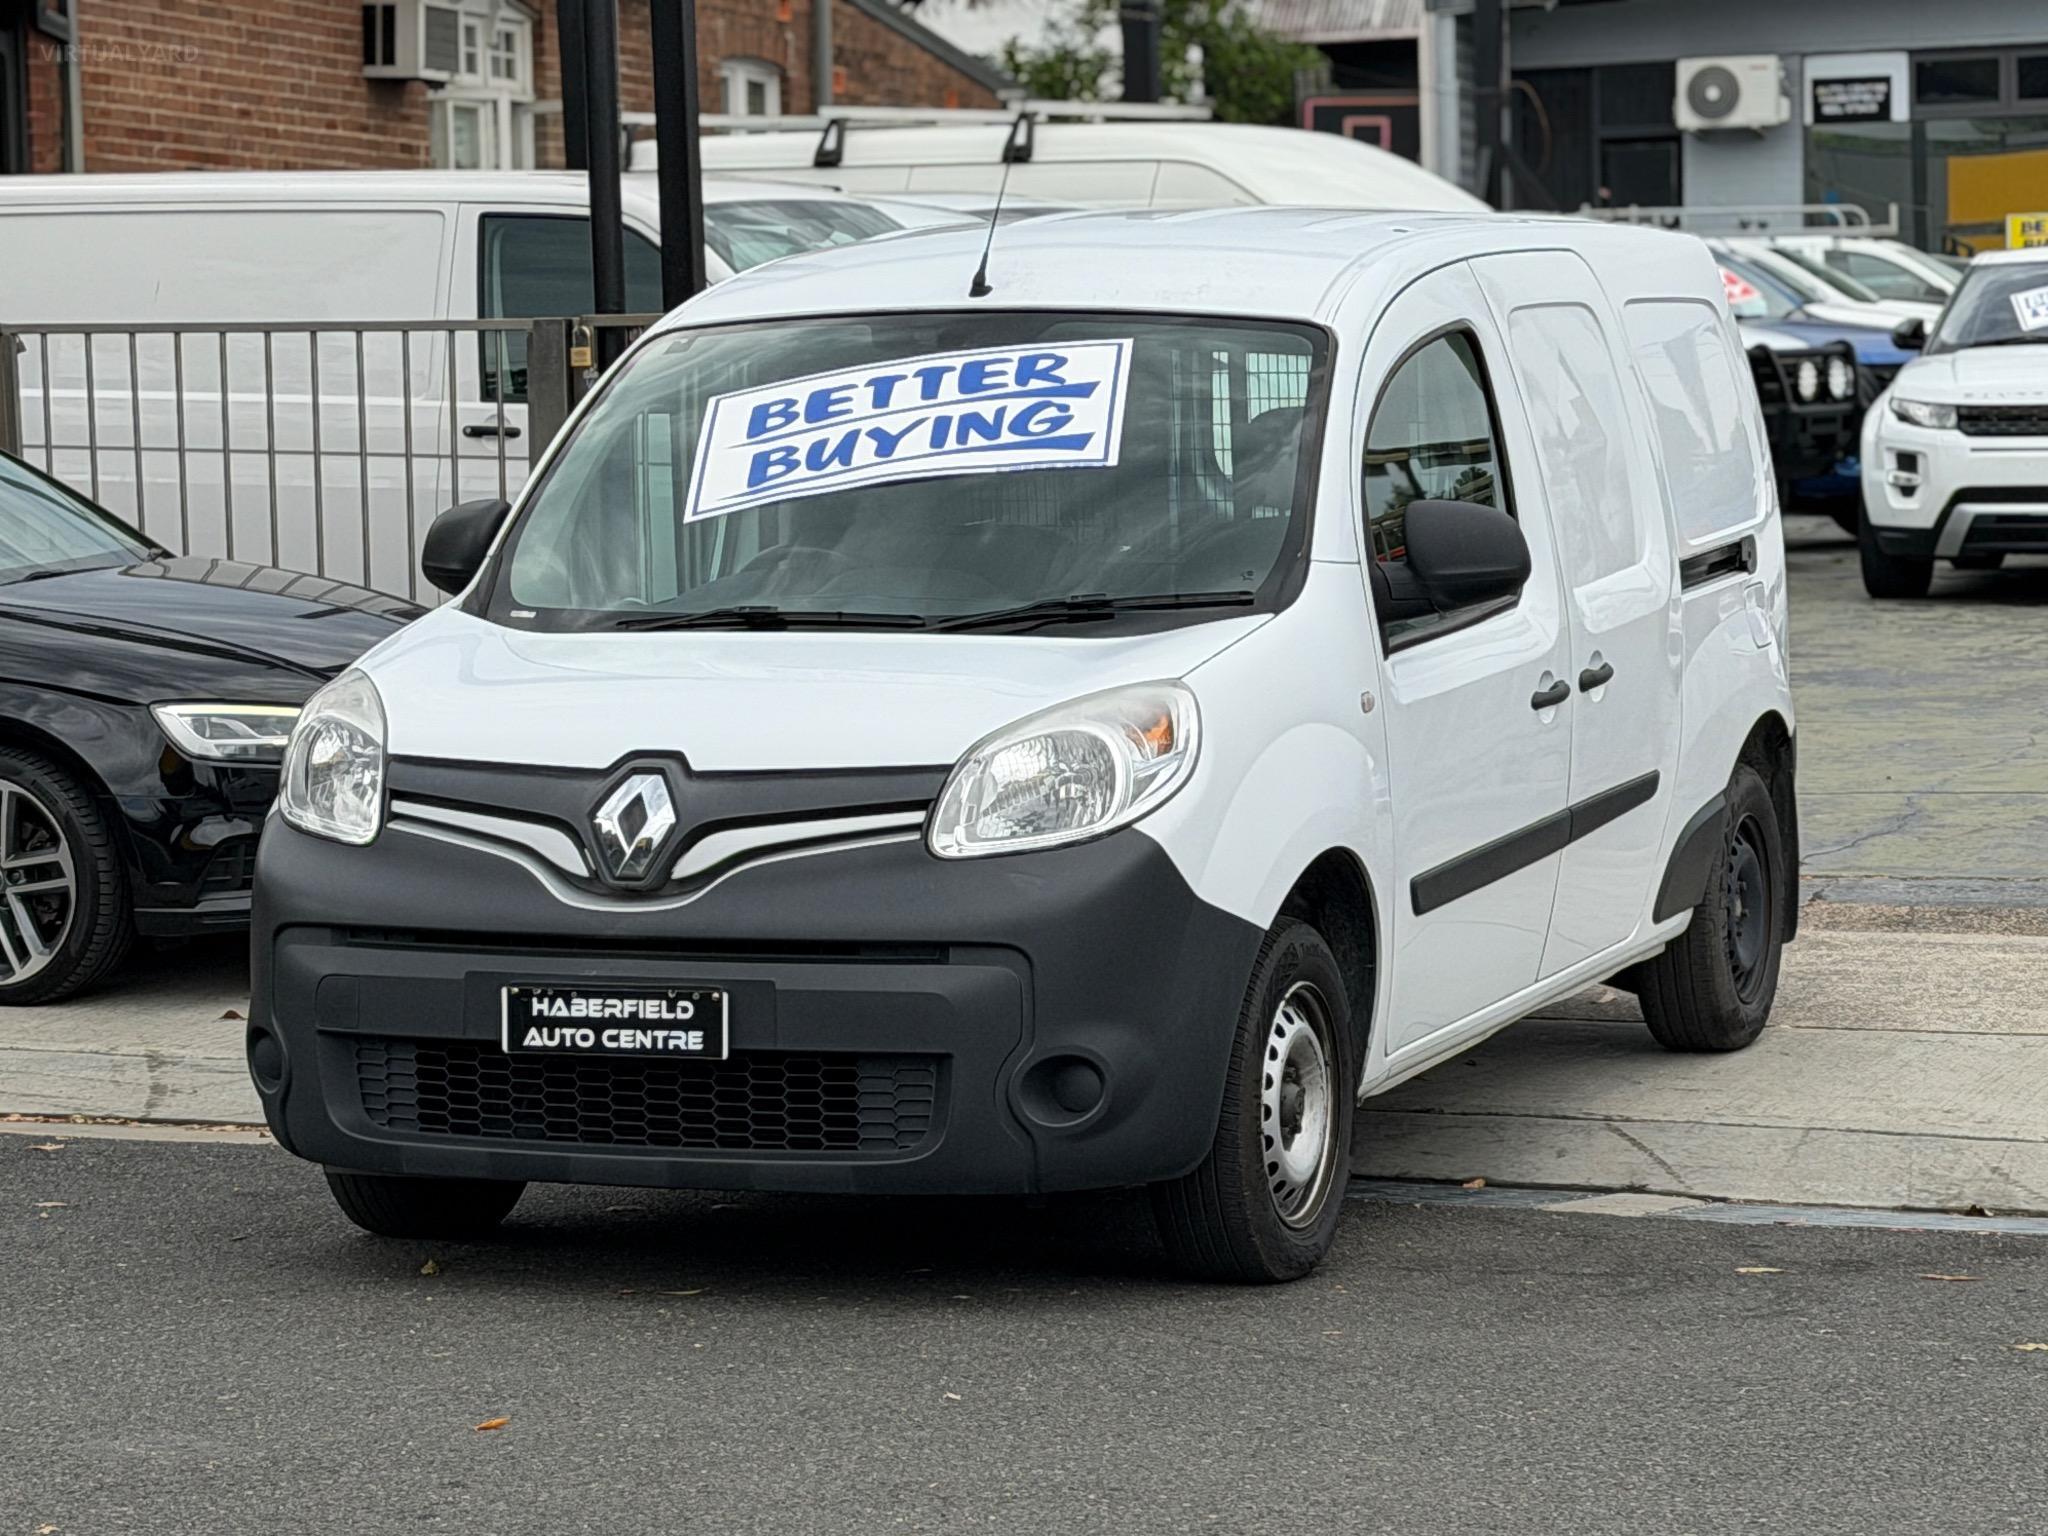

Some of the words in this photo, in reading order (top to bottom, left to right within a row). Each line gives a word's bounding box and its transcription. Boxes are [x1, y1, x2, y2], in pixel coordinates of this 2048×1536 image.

[746, 353, 1068, 440] BETTER
[746, 400, 1074, 489] BUYING
[532, 997, 694, 1019] HABERFIELD
[523, 1026, 595, 1047] AUTO
[602, 1029, 704, 1050] CENTRE
